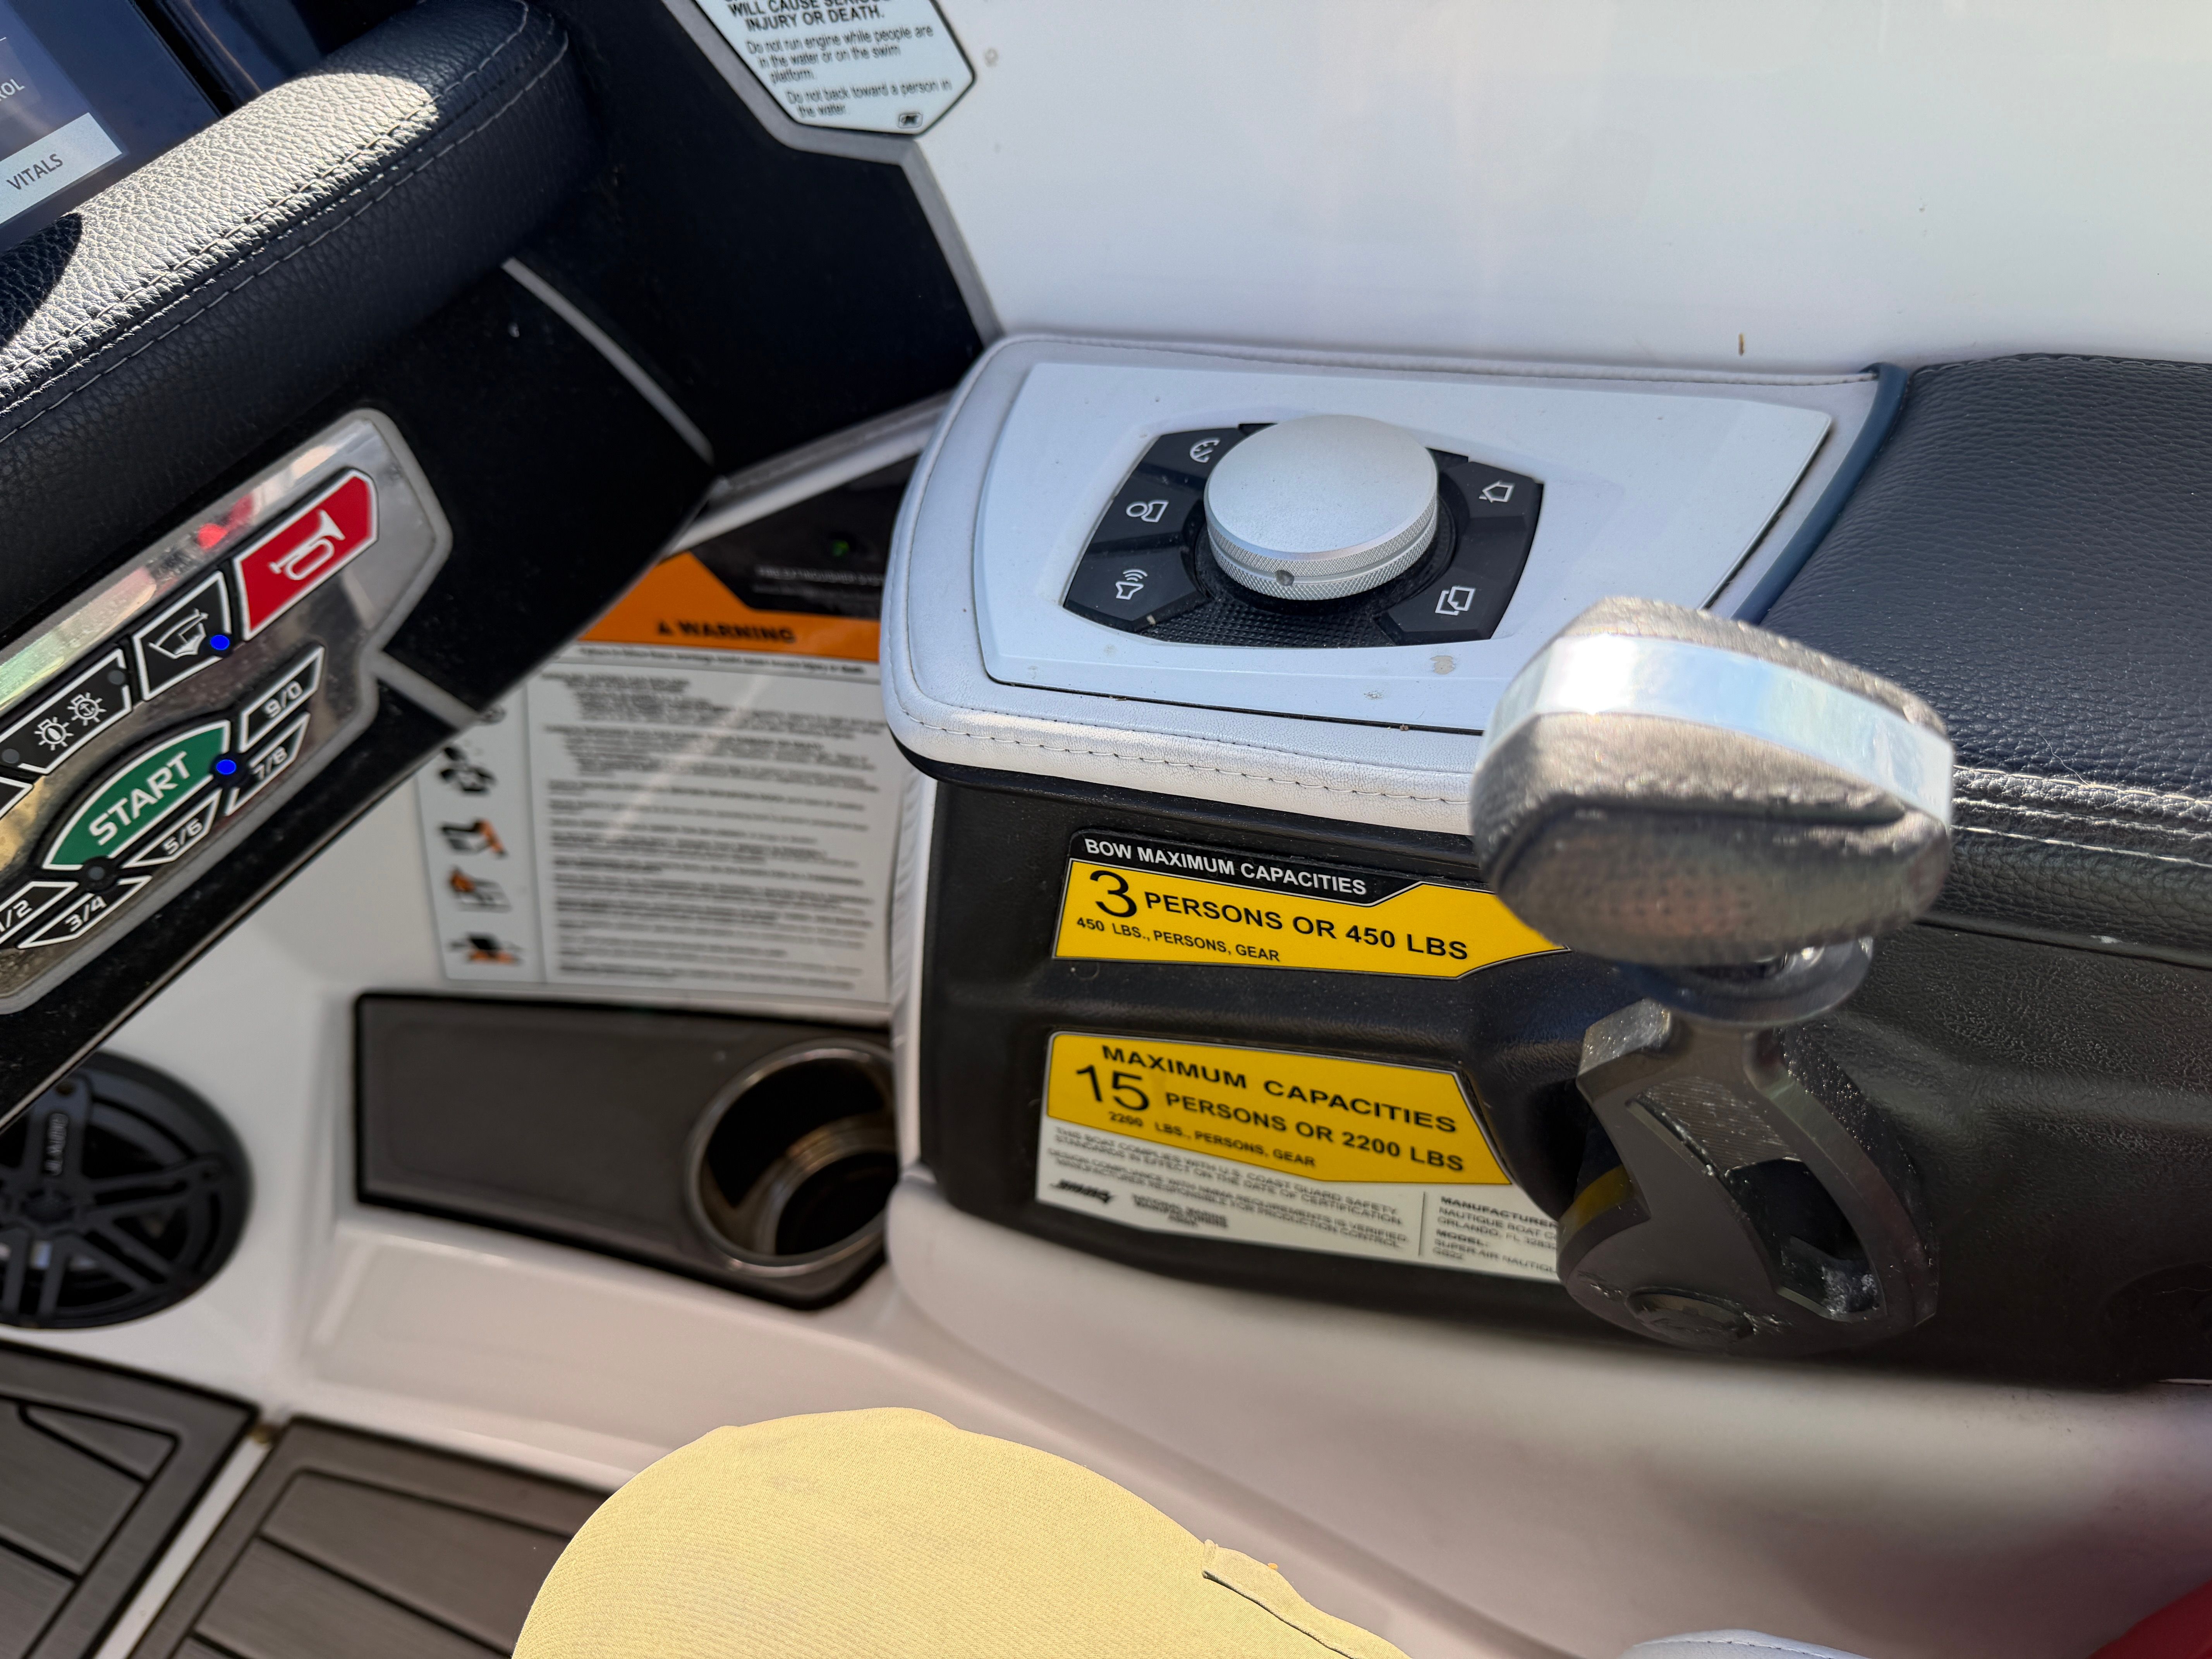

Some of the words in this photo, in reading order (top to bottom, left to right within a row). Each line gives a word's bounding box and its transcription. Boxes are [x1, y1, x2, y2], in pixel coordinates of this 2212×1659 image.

[728, 2, 764, 17] WILL
[745, 13, 797, 32] INJURY
[802, 10, 825, 26] OR
[827, 5, 885, 23] DEATH.
[745, 39, 764, 55] Do
[764, 38, 783, 52] not
[783, 38, 803, 51] run
[804, 34, 841, 51] engine
[842, 28, 872, 44] while
[873, 25, 912, 44] people
[914, 25, 934, 38] are
[758, 55, 769, 69] in
[769, 54, 788, 68] the
[789, 51, 819, 65] water
[820, 50, 832, 63] or
[834, 49, 850, 62] on
[850, 45, 870, 60] the
[872, 43, 901, 58] swim
[785, 88, 804, 104] Do
[805, 88, 823, 102] not
[822, 85, 850, 101] back
[850, 80, 889, 98] toward
[890, 82, 898, 96] a
[899, 80, 939, 98] person
[940, 78, 953, 91] in
[797, 104, 816, 118] the
[7, 153, 63, 190] VITALS
[677, 620, 797, 644] WARNING
[263, 680, 303, 720] 9/0
[254, 747, 287, 781] 7/8
[89, 752, 191, 845] START
[163, 819, 203, 855] 5/6
[1084, 838, 1132, 860] BOW
[1137, 846, 1235, 876] MAXIMUM
[1240, 862, 1367, 896] CAPACITIES
[65, 896, 107, 932] 3/4
[1089, 869, 1138, 918] 3
[1144, 891, 1284, 931] PERSONS
[1292, 915, 1336, 940] OR
[1345, 924, 1396, 949] 450
[1406, 933, 1468, 960] LBS
[1076, 916, 1106, 933] 450
[1111, 922, 1151, 942] LBS.,
[1153, 929, 1232, 957] PERSONS,
[1235, 943, 1280, 962] GEAR
[1101, 1044, 1247, 1089] MAXIMUM
[1263, 1079, 1457, 1134] CAPACITIES
[1075, 1063, 1150, 1113] 15
[1165, 1092, 1287, 1132] PERSONS
[1295, 1121, 1334, 1144] OR
[1341, 1131, 1401, 1158] 2200
[1410, 1145, 1464, 1173] LBS
[1108, 1111, 1144, 1127] 2200
[1194, 1130, 1269, 1158] PERSONS,
[1273, 1148, 1316, 1167] GEAR
[1246, 1171, 1290, 1190] COAST
[1294, 1182, 1341, 1202] GUARD
[1436, 1228, 1488, 1247] MODEL:
[1439, 1206, 1504, 1228] NAUTIQUE
[1507, 1222, 1541, 1237] BOAT
[1506, 1231, 1520, 1242] FL
[1434, 1238, 1476, 1255] SUPER
[1479, 1249, 1499, 1260] AIR
